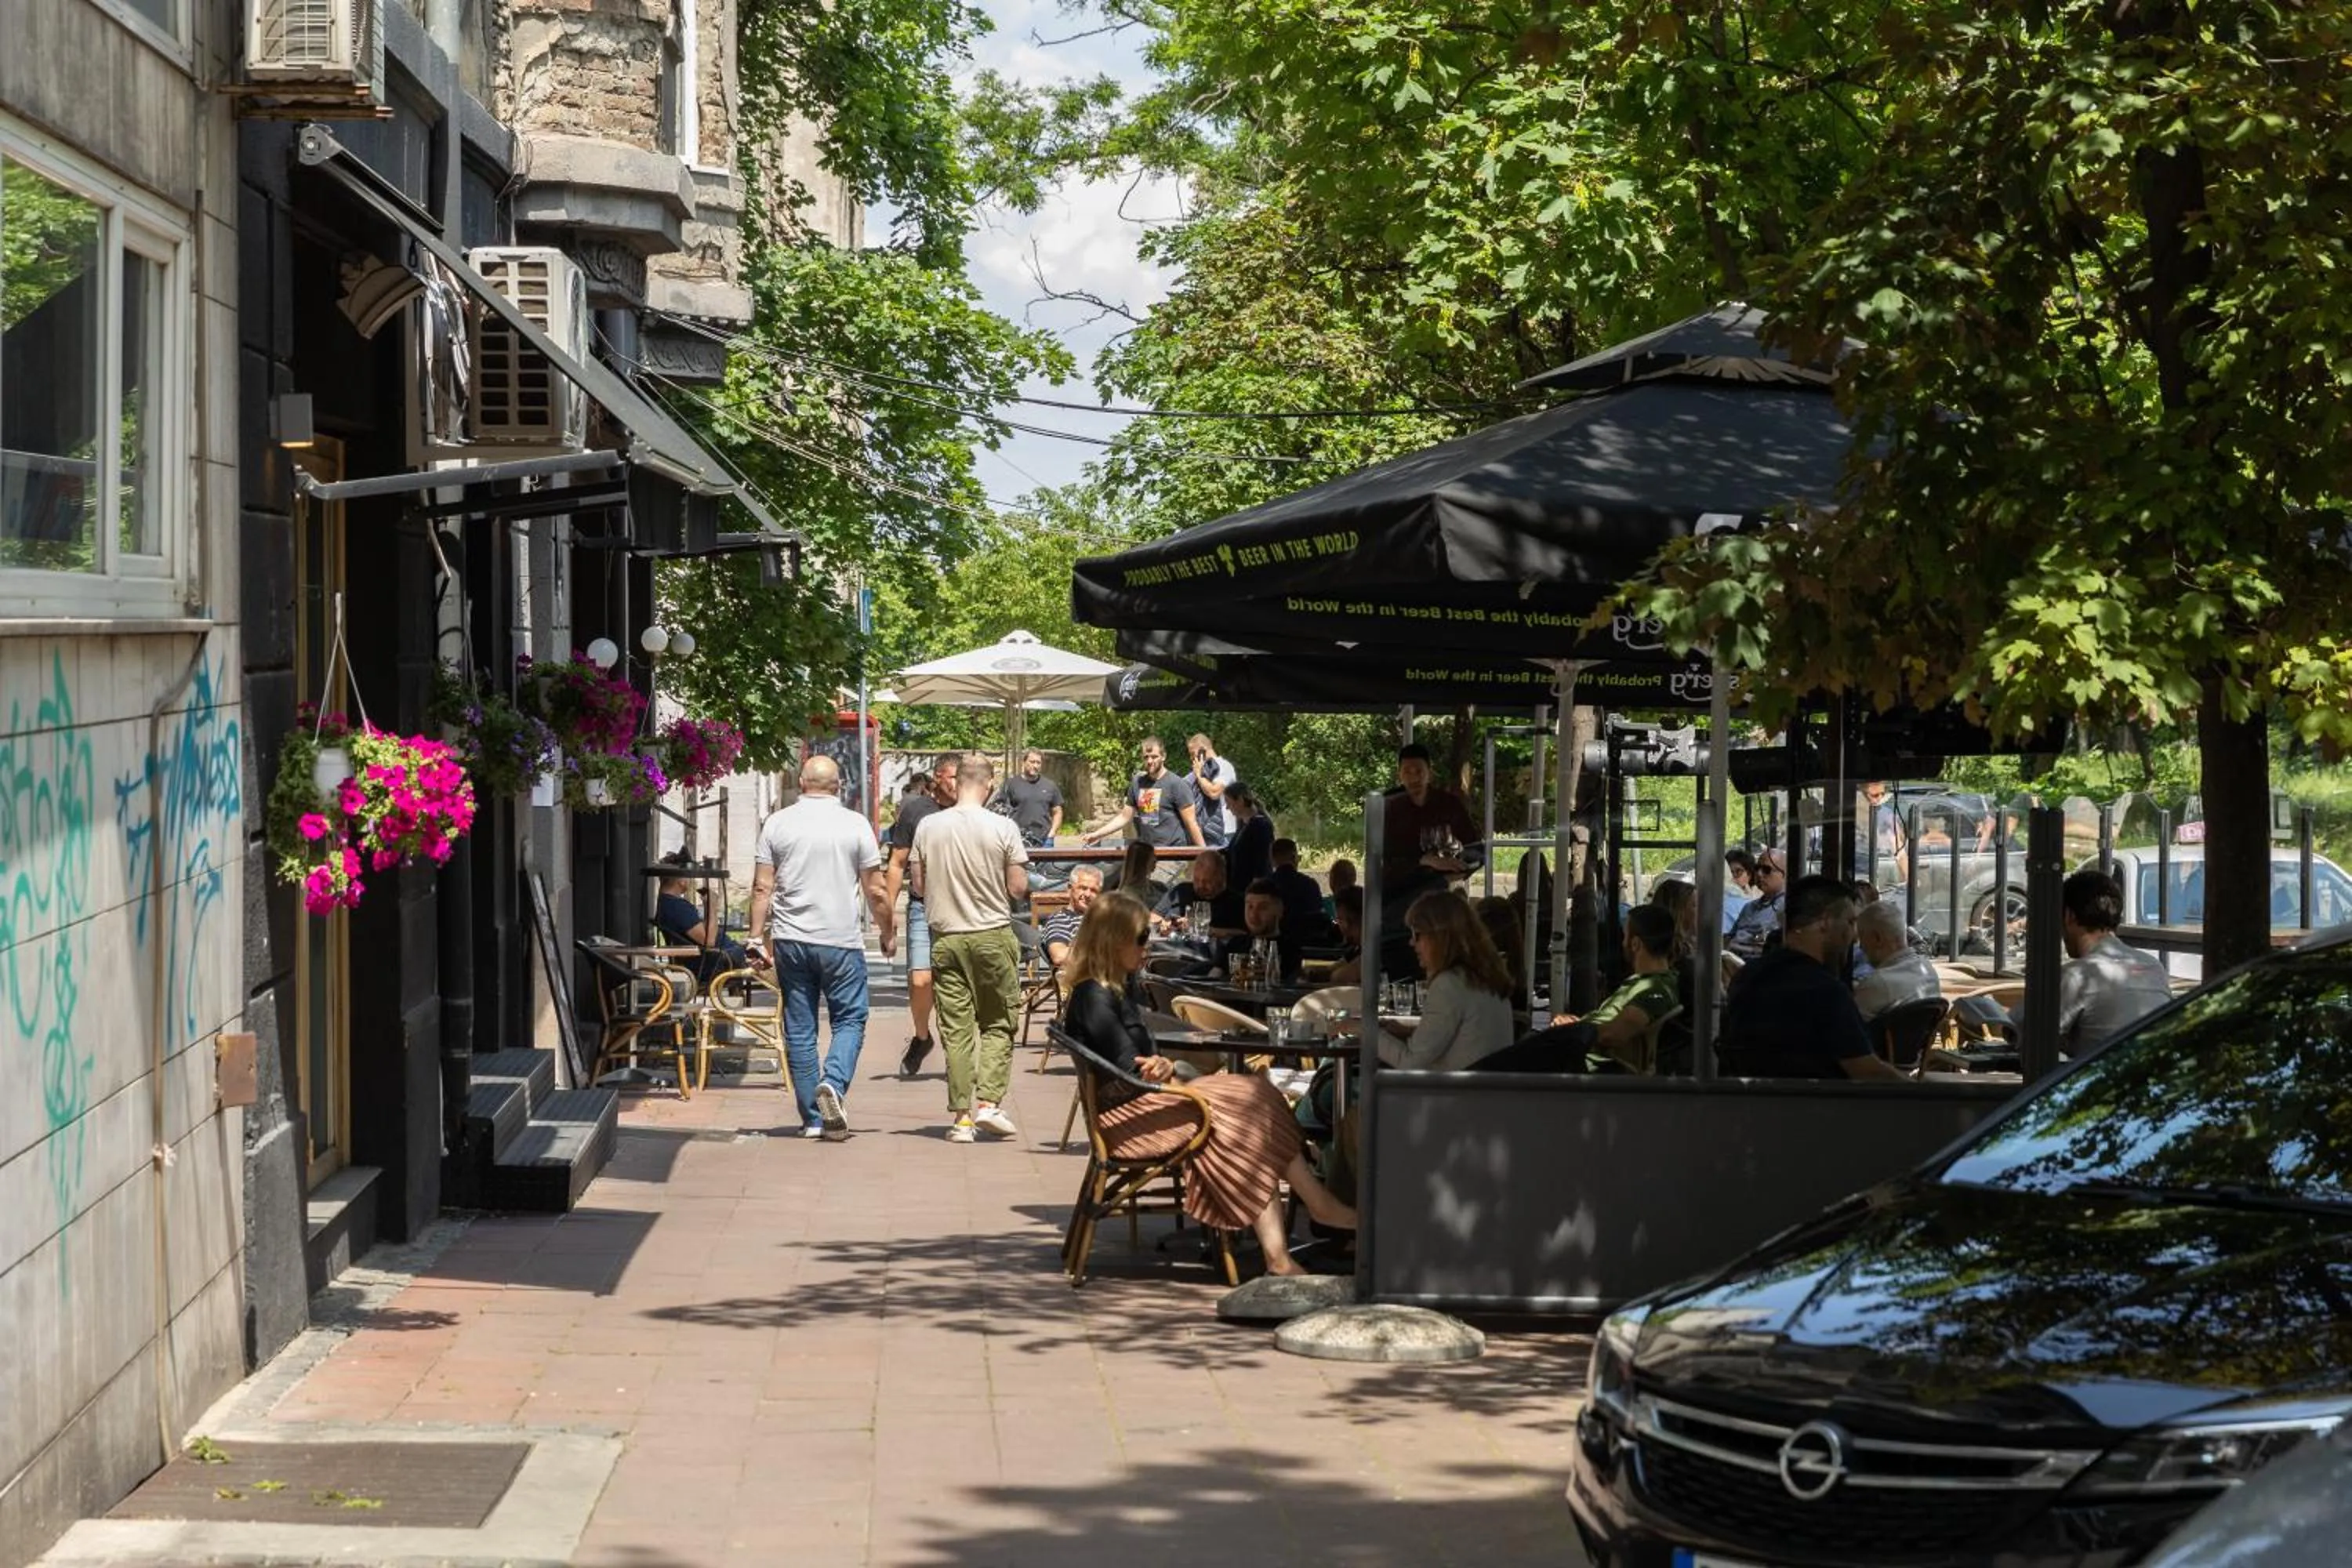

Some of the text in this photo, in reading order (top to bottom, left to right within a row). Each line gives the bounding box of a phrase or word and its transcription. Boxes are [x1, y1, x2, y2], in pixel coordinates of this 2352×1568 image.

[1170, 559, 1192, 579] THE
[1191, 554, 1219, 575] BEST
[1237, 545, 1271, 567] BEER
[1269, 542, 1287, 562] IN
[1285, 539, 1312, 558] THE
[1313, 531, 1359, 555] WORLD
